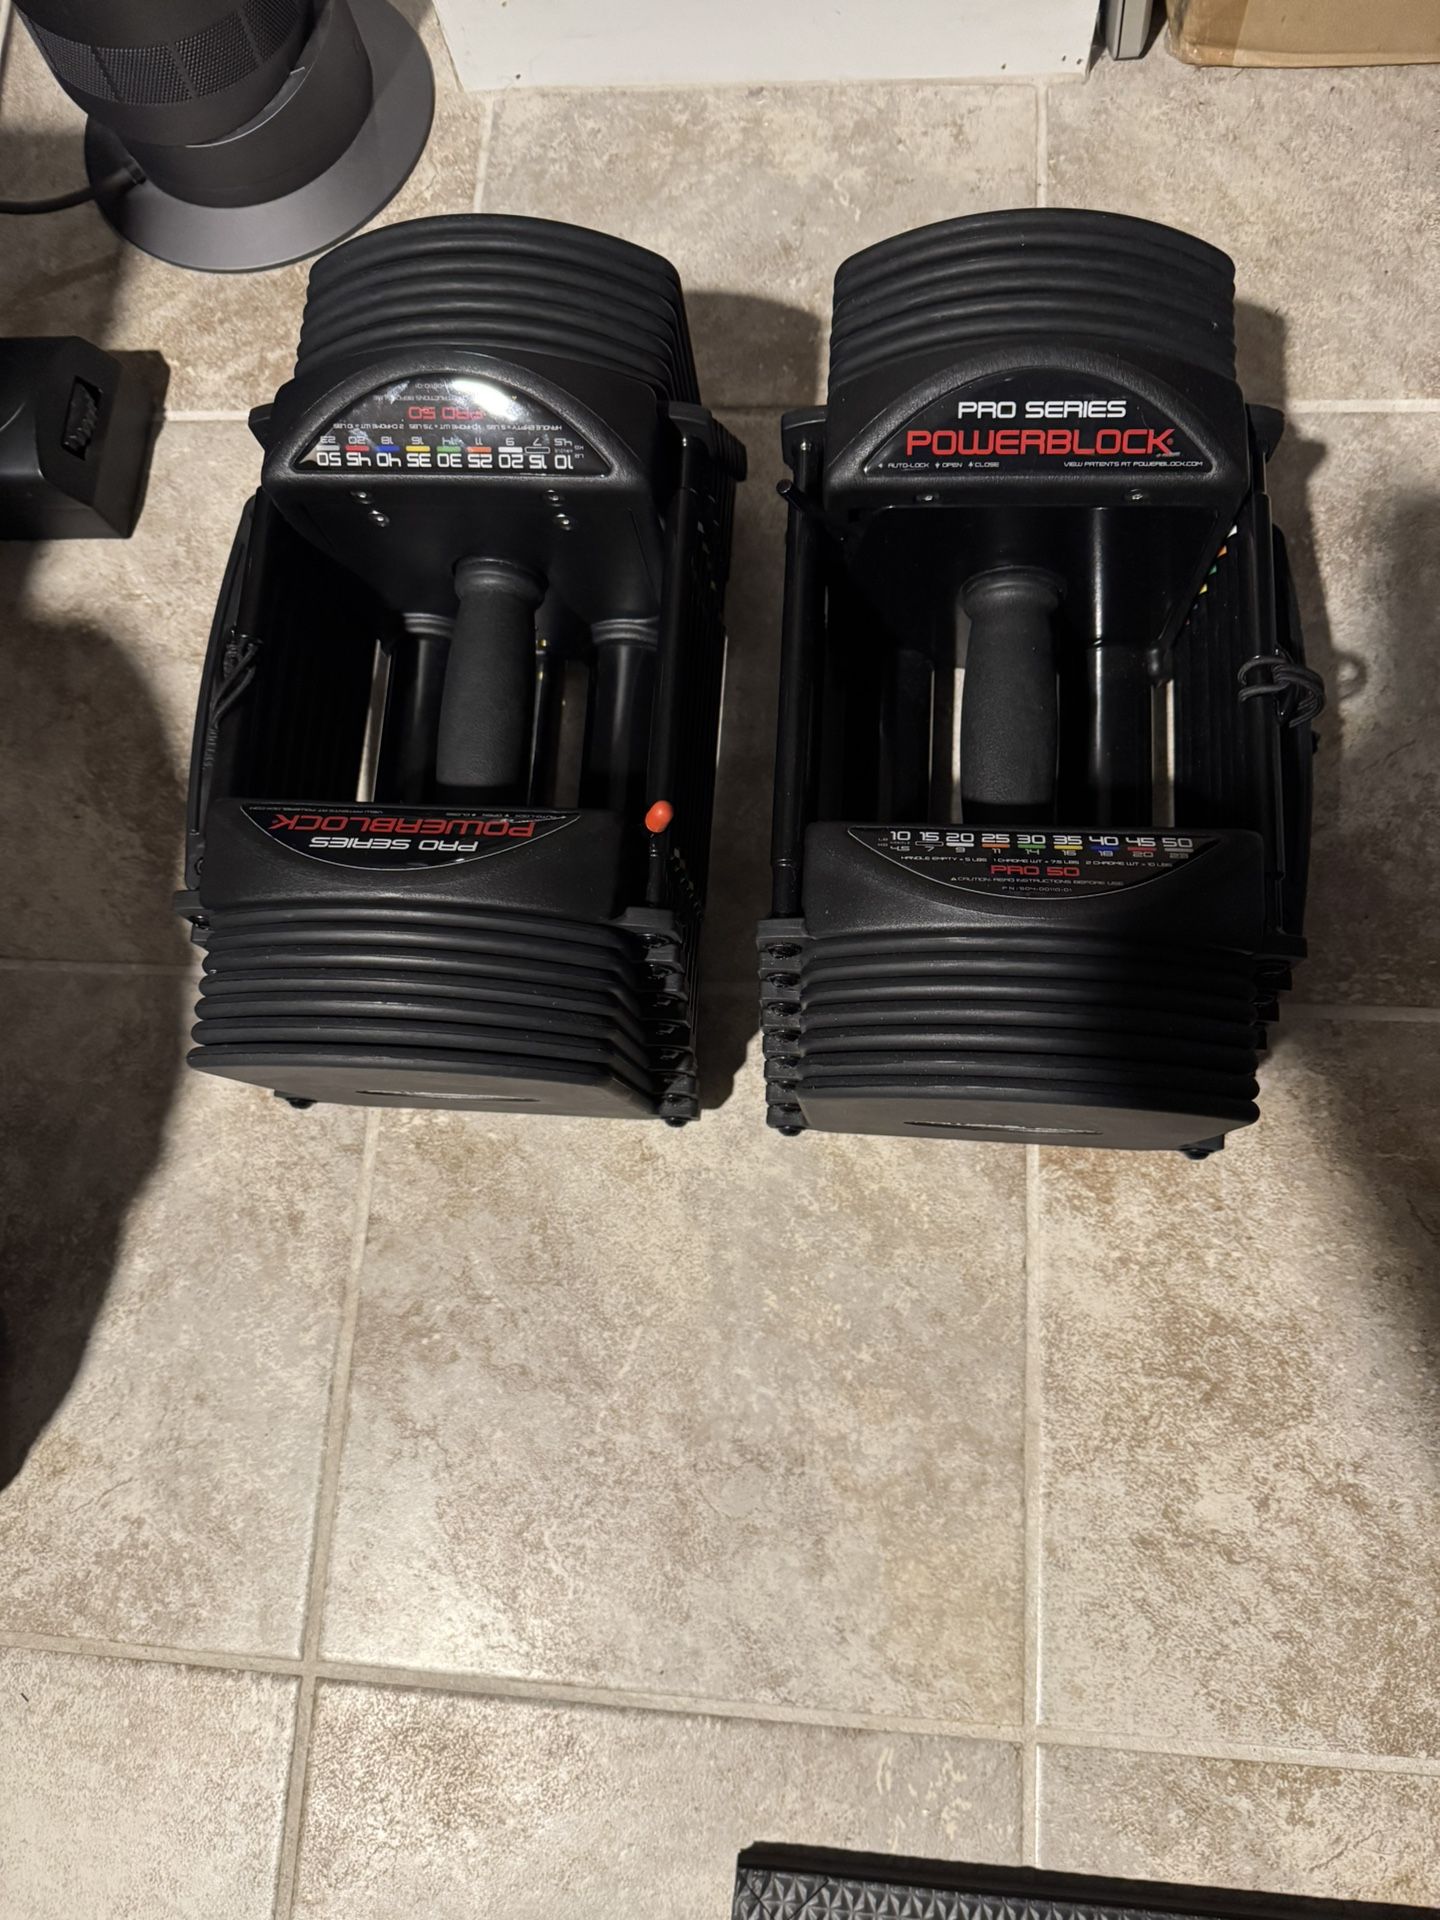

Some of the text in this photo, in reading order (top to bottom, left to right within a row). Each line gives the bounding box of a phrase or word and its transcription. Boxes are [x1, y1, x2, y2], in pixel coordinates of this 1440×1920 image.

[408, 406, 485, 420] PRO 50
[958, 400, 1127, 419] PRO SERIES
[320, 435, 336, 444] 23
[348, 436, 366, 444] 20
[381, 436, 394, 444] 18
[411, 436, 424, 444] 16
[442, 437, 457, 445] 14
[475, 437, 483, 445] 11
[505, 437, 515, 446] 9
[532, 438, 542, 446] 7
[906, 428, 1175, 456] POWERBLOCK
[317, 452, 574, 469] 10 15 20 25 30 35 40 45 50
[268, 814, 535, 837] POWERBLOCK
[308, 836, 479, 852] PRO SERIES
[890, 831, 1193, 848] 10 15 20 25 30 35 40 45 50
[990, 865, 1080, 877] PRO 50
